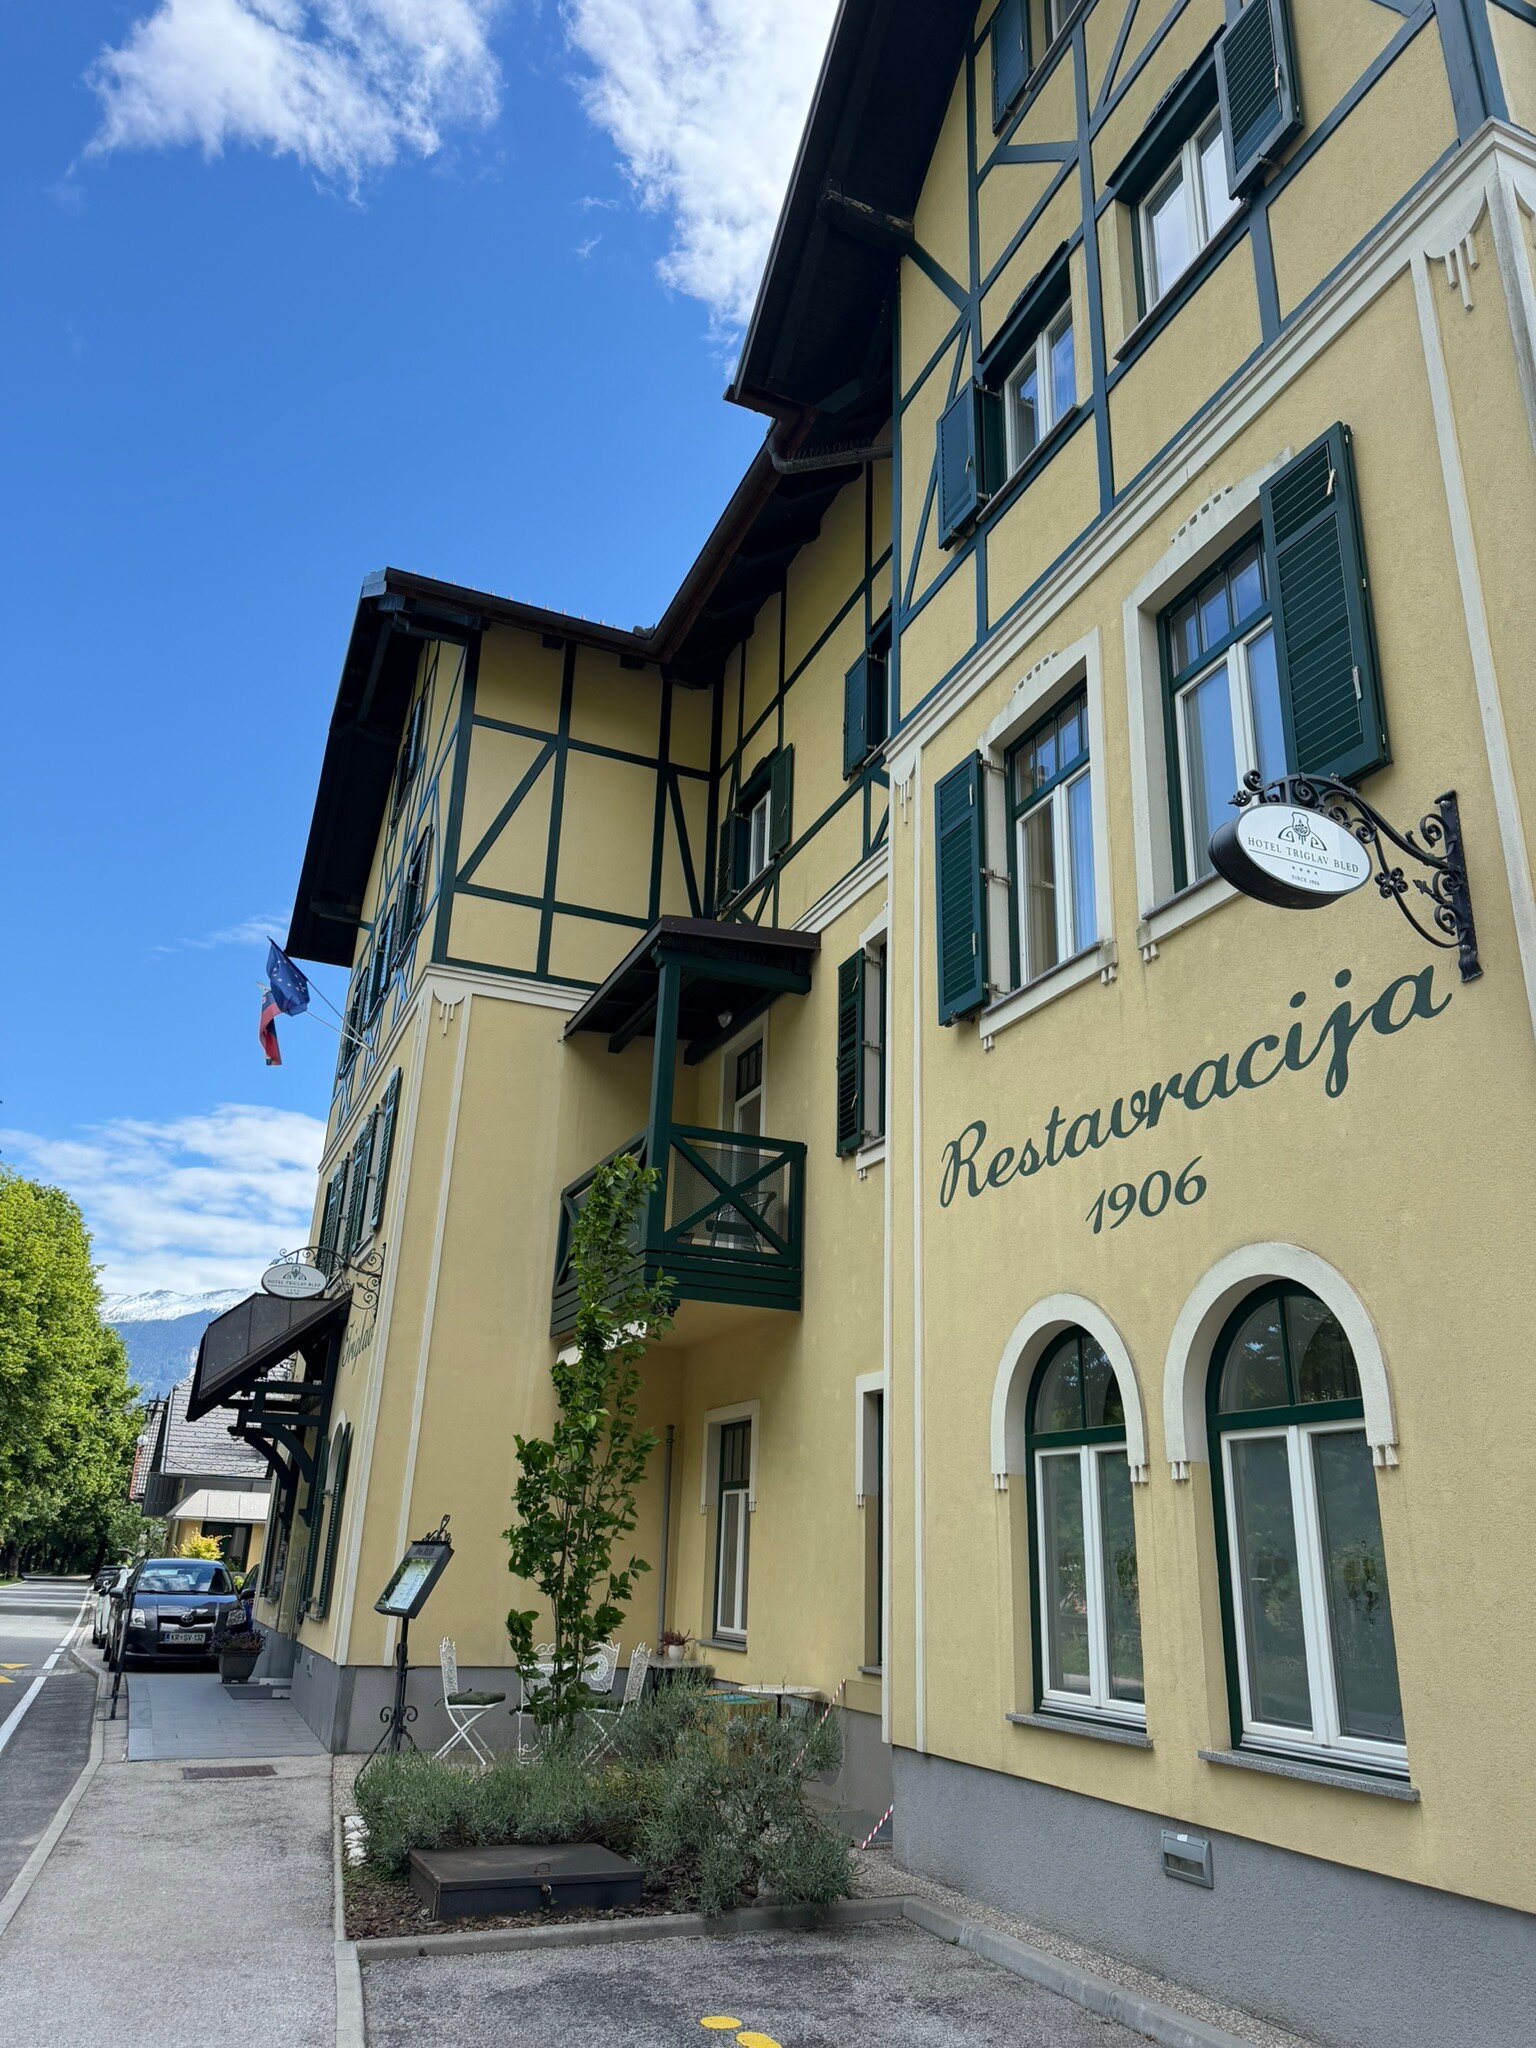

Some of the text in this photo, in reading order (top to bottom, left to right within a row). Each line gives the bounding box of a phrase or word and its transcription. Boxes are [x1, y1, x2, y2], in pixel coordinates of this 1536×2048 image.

[1247, 837, 1359, 873] HOTEL TRIGLAV BLED
[941, 965, 1452, 1208] Restavracija
[1085, 1155, 1207, 1234] 1906
